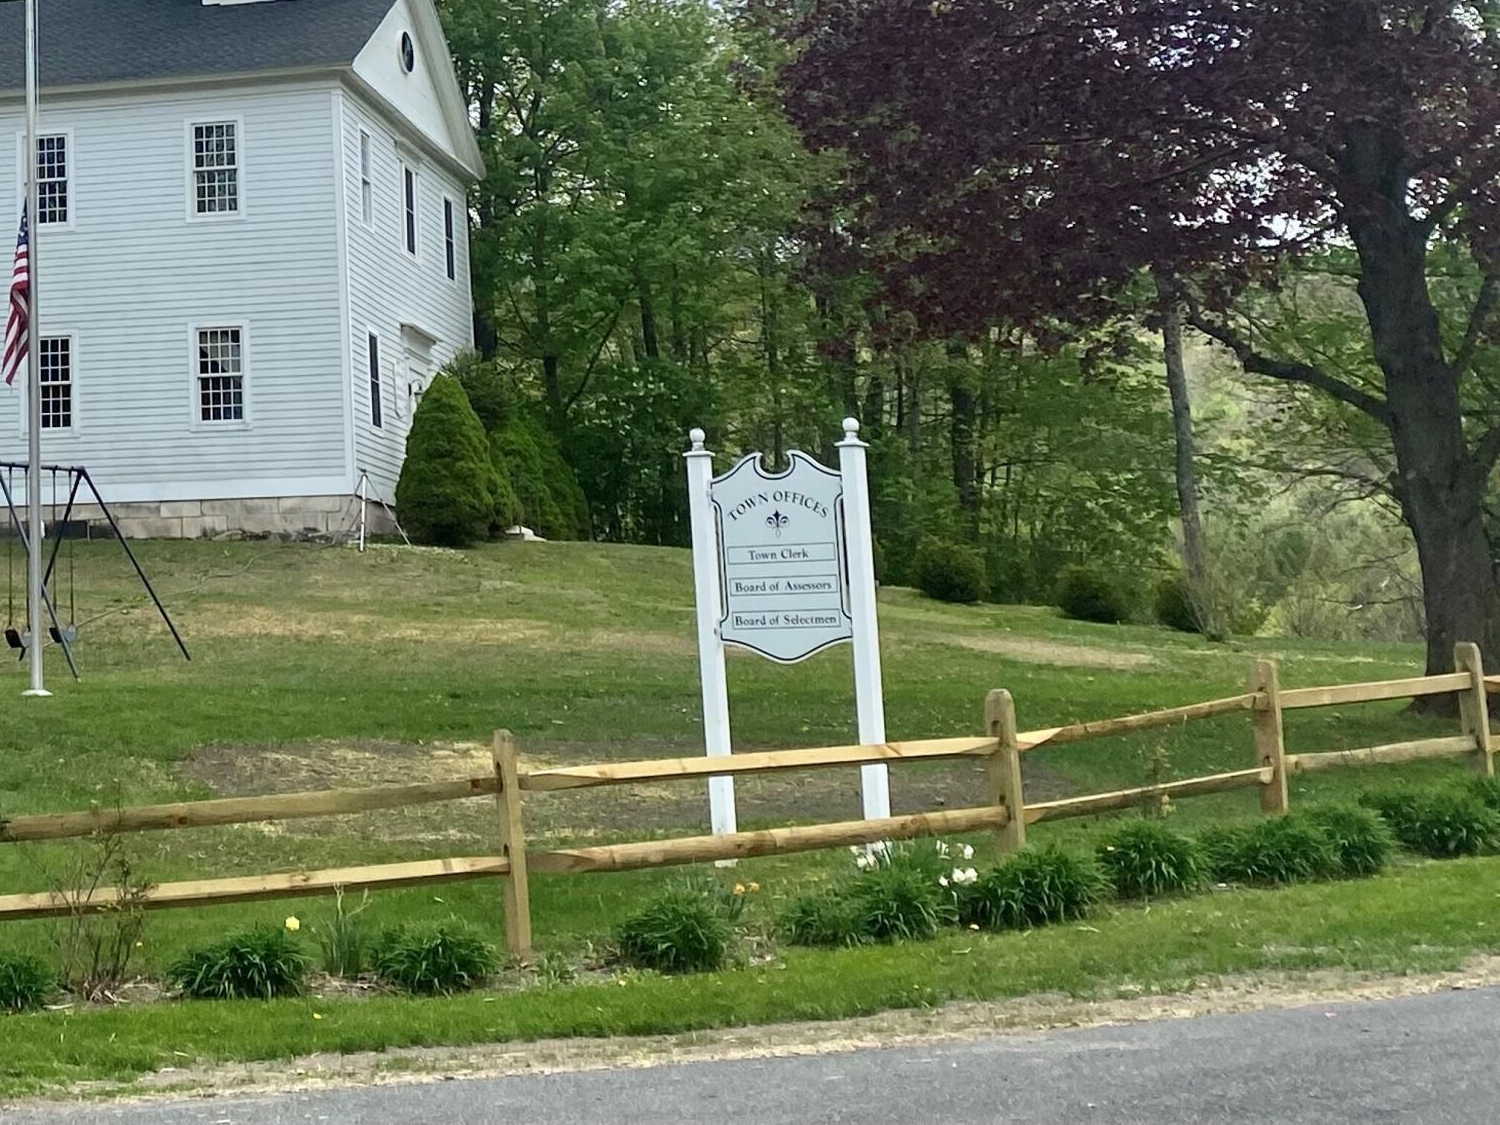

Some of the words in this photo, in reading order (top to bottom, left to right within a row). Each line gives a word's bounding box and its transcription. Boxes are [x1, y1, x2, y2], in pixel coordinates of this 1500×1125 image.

[727, 492, 769, 521] TOWN
[773, 490, 829, 518] OFFICES
[748, 550, 777, 560] Town
[780, 548, 809, 559] Clerk
[735, 582, 766, 592] Board
[769, 581, 780, 591] of
[785, 580, 832, 591] Assessors
[735, 615, 766, 626] Board
[769, 614, 780, 625] of
[783, 613, 837, 625] Selectmen
